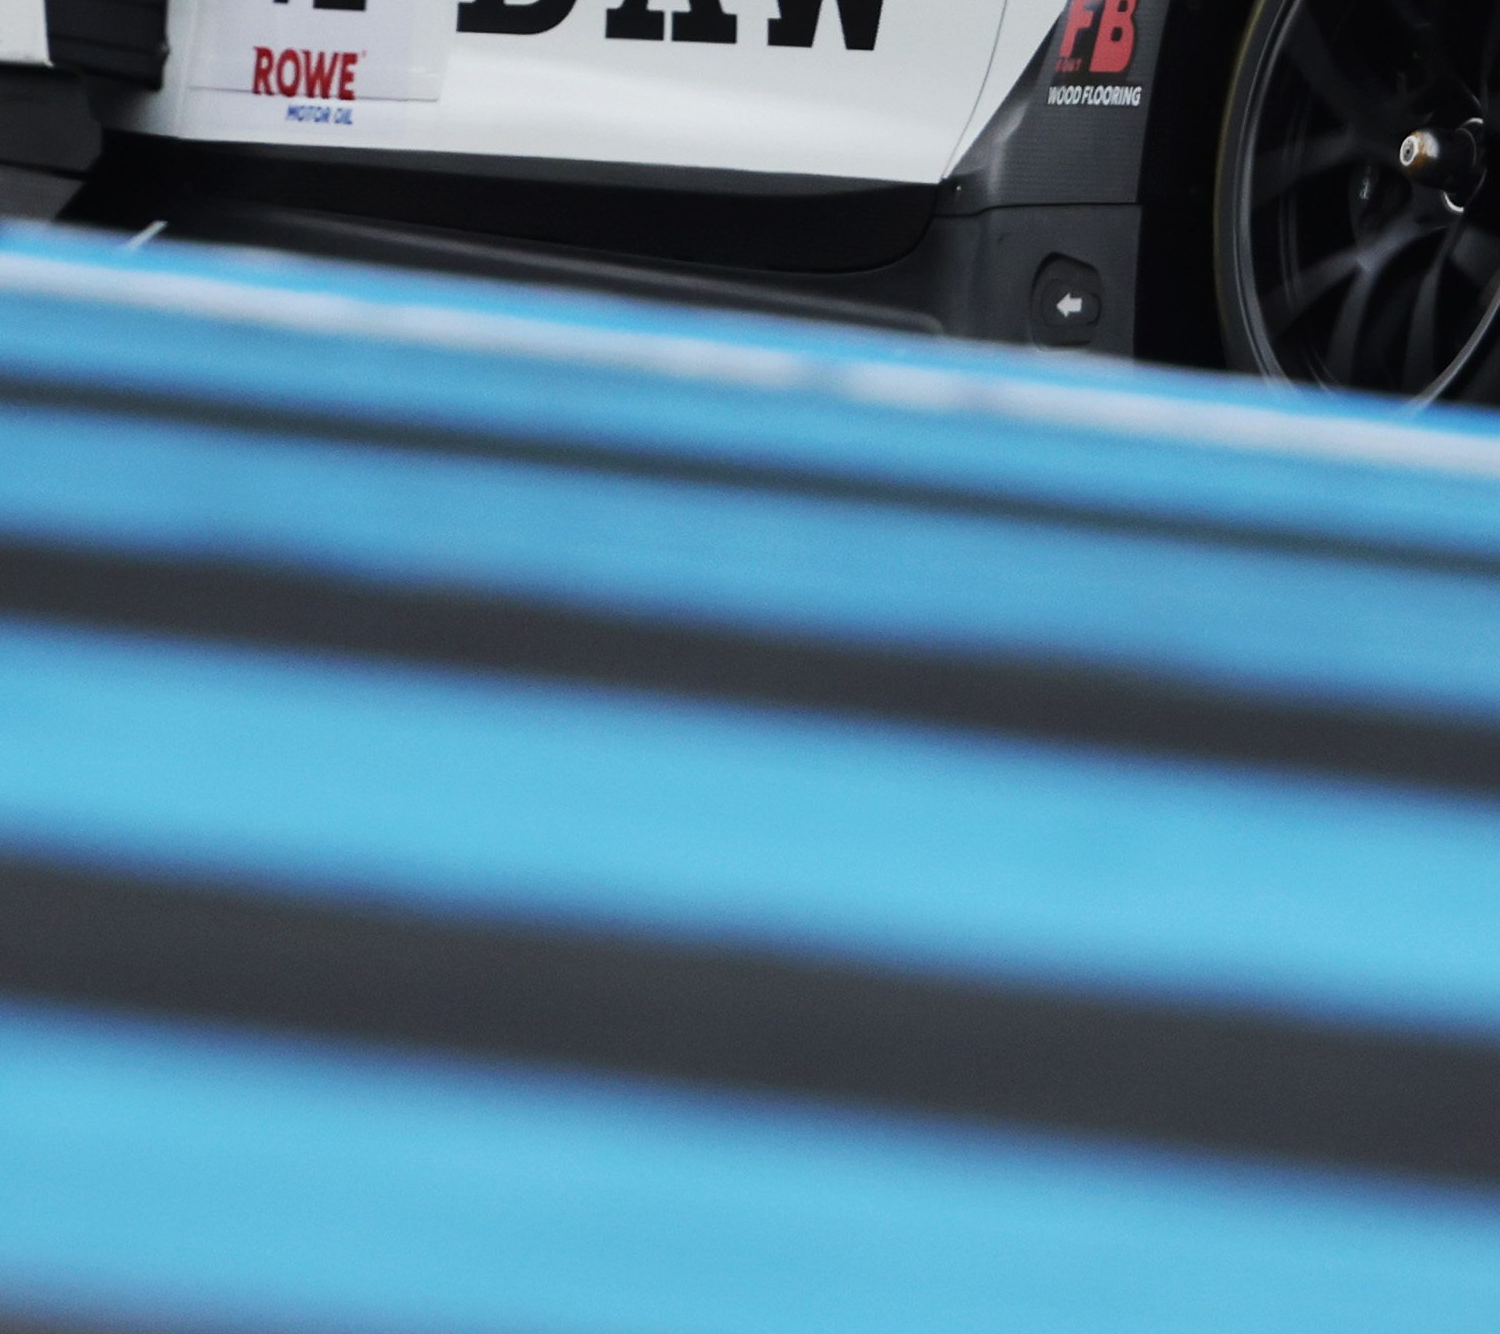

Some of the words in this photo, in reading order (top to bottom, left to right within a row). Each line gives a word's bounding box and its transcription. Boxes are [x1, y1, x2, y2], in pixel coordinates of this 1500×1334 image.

[251, 46, 358, 100] ROWE
[1047, 85, 1082, 105] WOOD
[1081, 85, 1142, 106] FLOORING
